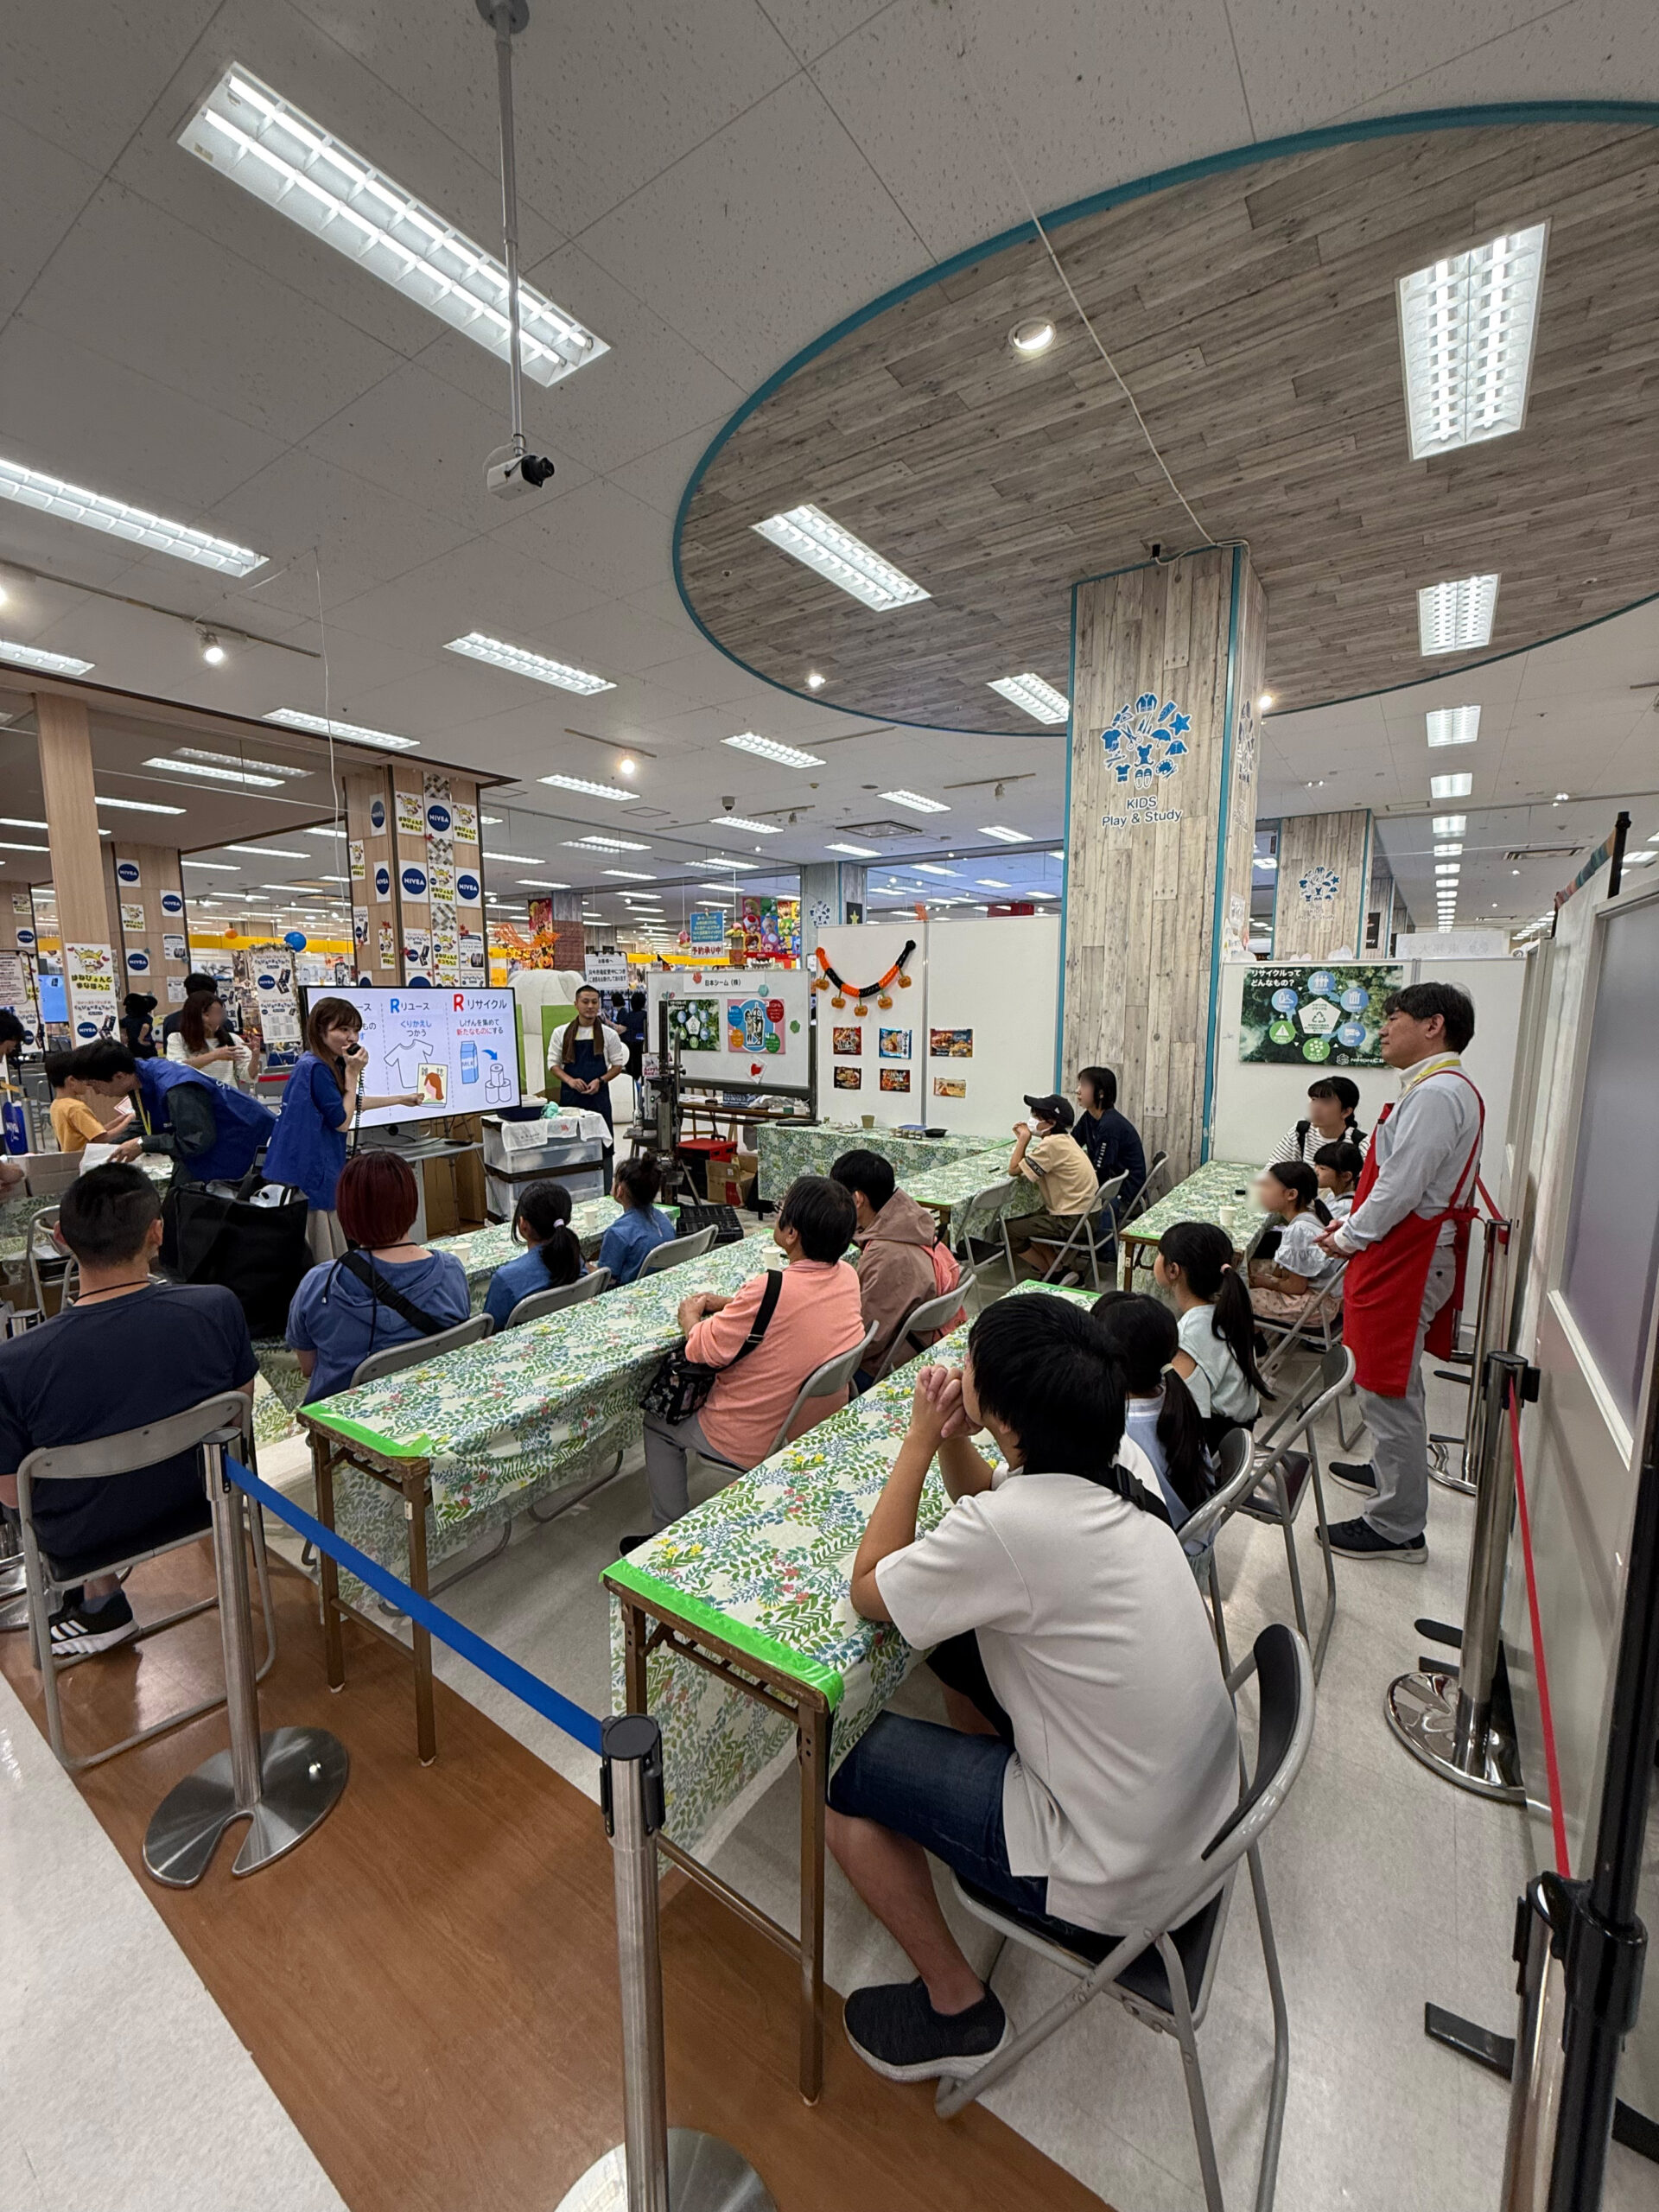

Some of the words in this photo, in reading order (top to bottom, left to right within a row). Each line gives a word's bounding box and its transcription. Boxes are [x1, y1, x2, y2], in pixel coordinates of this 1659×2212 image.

[1127, 796, 1158, 810] KIDS
[429, 814, 449, 823] NIVEA
[1102, 815, 1128, 827] Play
[1131, 812, 1141, 824] &
[1145, 809, 1183, 823] Study
[404, 877, 425, 886] NIVEA
[459, 883, 478, 892] NIVEA
[691, 946, 721, 955] 予約承り中
[1252, 969, 1302, 978] リサイクルって
[356, 1002, 372, 1012] ース
[390, 997, 401, 1014] R
[400, 1001, 431, 1012] リユース
[453, 993, 465, 1013] R
[467, 999, 508, 1010] リサイクル
[361, 1021, 377, 1031] もの
[400, 1020, 433, 1028] くりかえし
[459, 1019, 499, 1027] しげんを集めて
[406, 1028, 427, 1037] つかう
